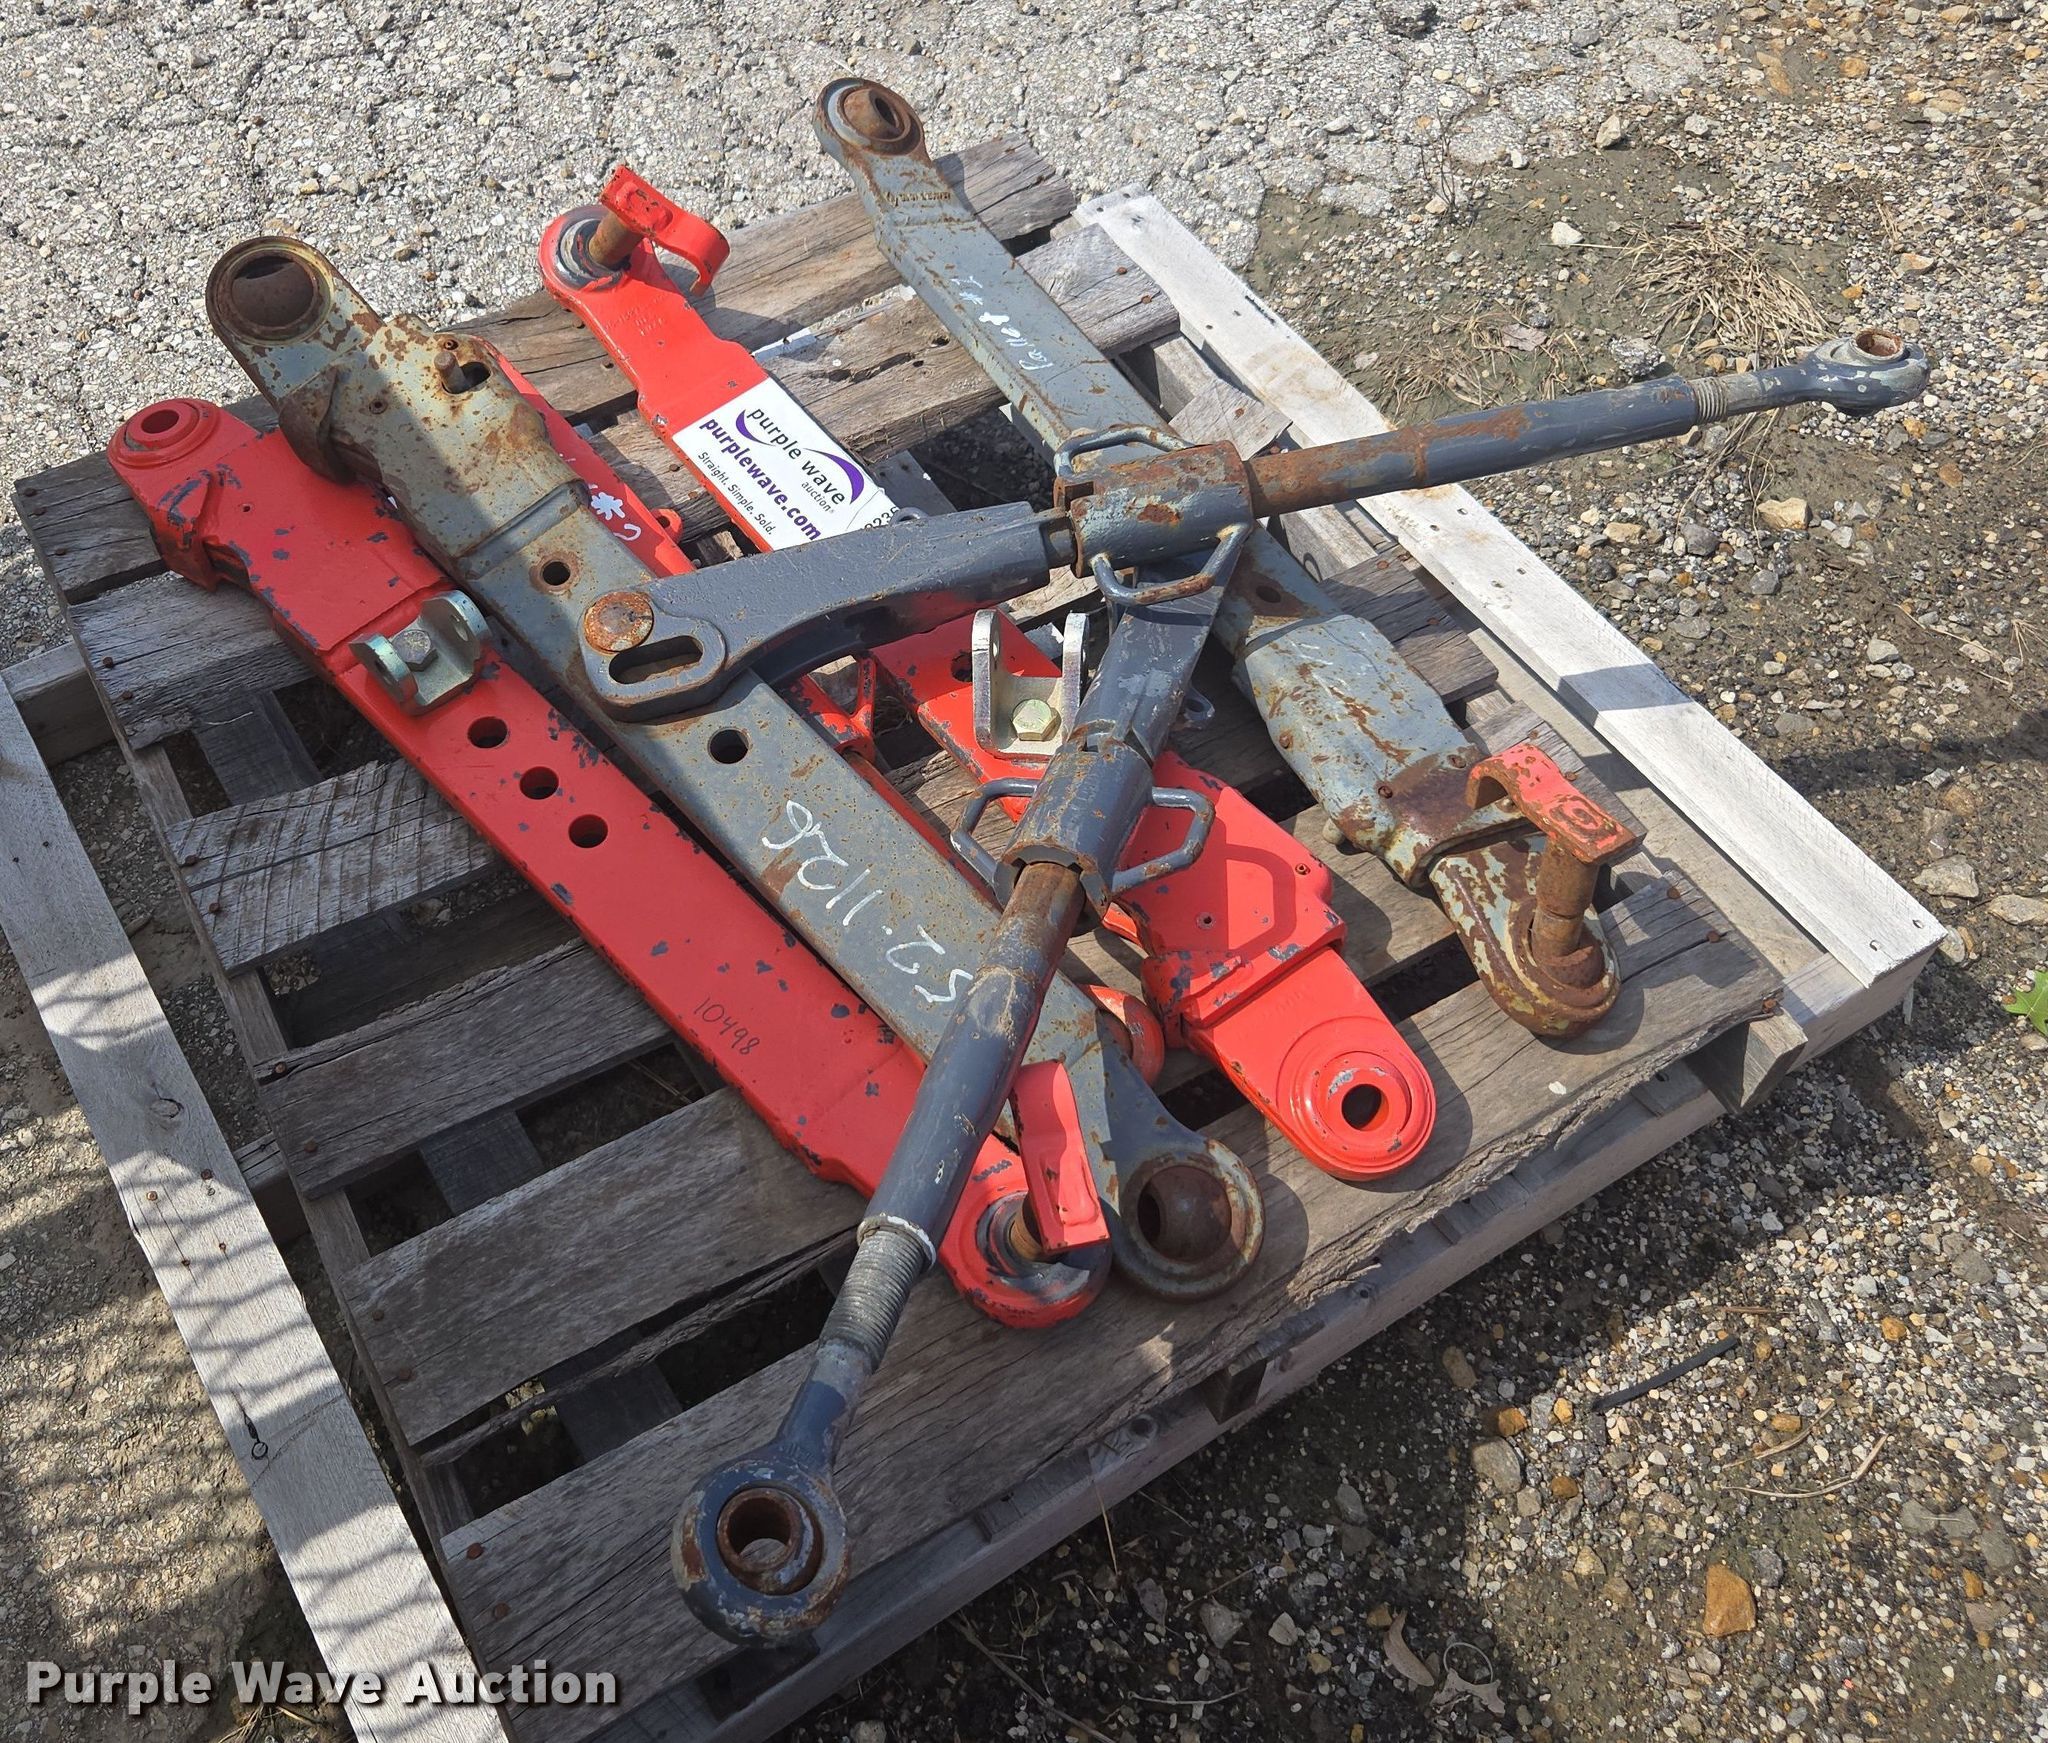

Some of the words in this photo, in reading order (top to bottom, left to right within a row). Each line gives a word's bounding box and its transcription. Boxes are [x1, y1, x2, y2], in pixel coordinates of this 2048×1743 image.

[698, 451, 727, 486] Straight.
[727, 484, 754, 515] Simple.
[754, 513, 773, 536] Sold.
[699, 418, 822, 541] purplewave.com
[746, 408, 802, 460] purple
[801, 460, 845, 505] wave
[693, 997, 760, 1055] 10498
